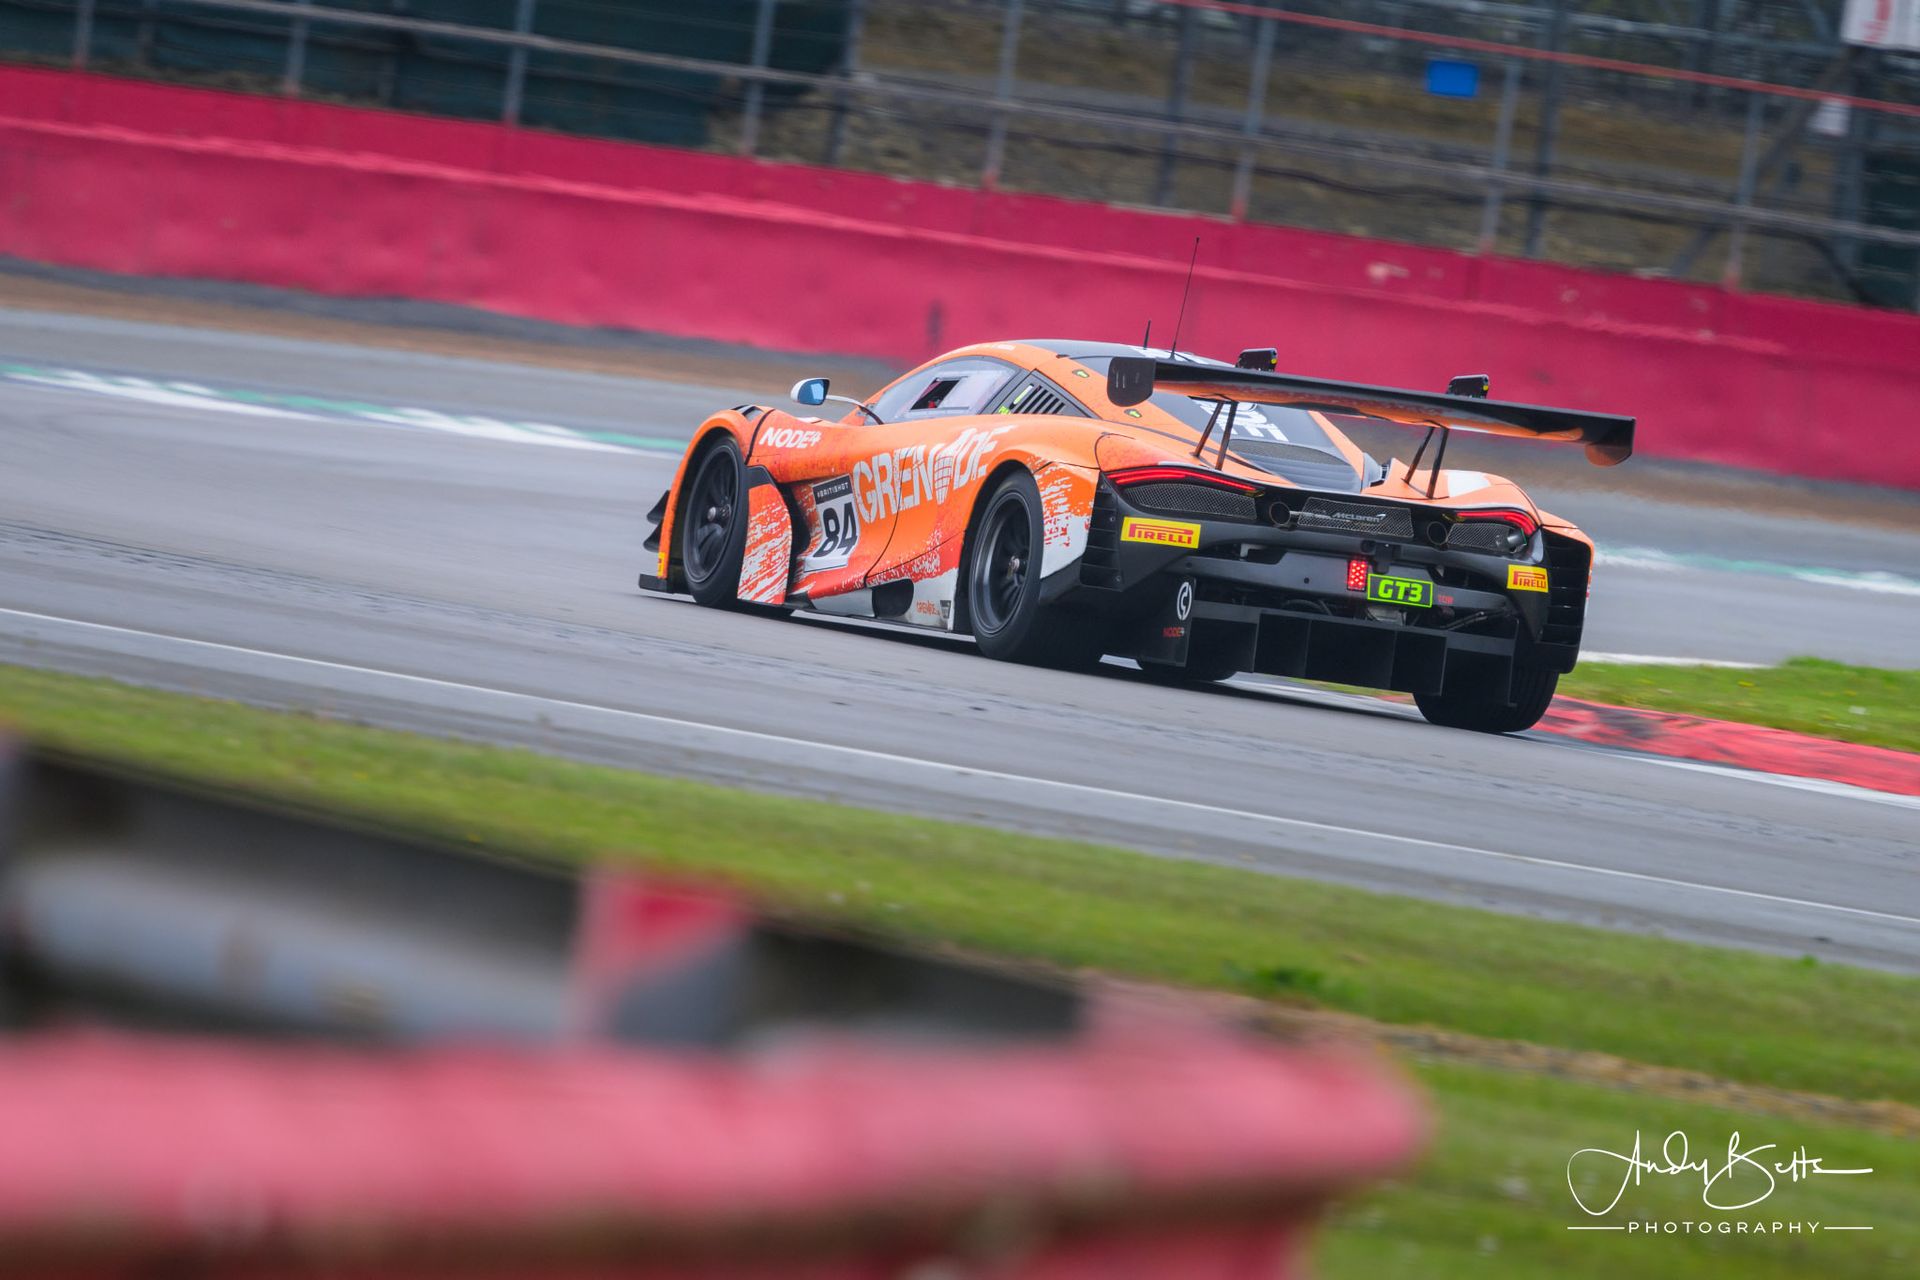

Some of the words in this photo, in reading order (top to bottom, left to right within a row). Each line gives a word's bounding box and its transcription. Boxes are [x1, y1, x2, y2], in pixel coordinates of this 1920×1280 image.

[852, 425, 1016, 524] GRENADE
[1331, 512, 1381, 523] McLaren
[812, 501, 858, 558] 84
[1128, 523, 1194, 545] PIRELLI
[1377, 579, 1423, 603] GT3
[1512, 570, 1547, 589] PIRELLI
